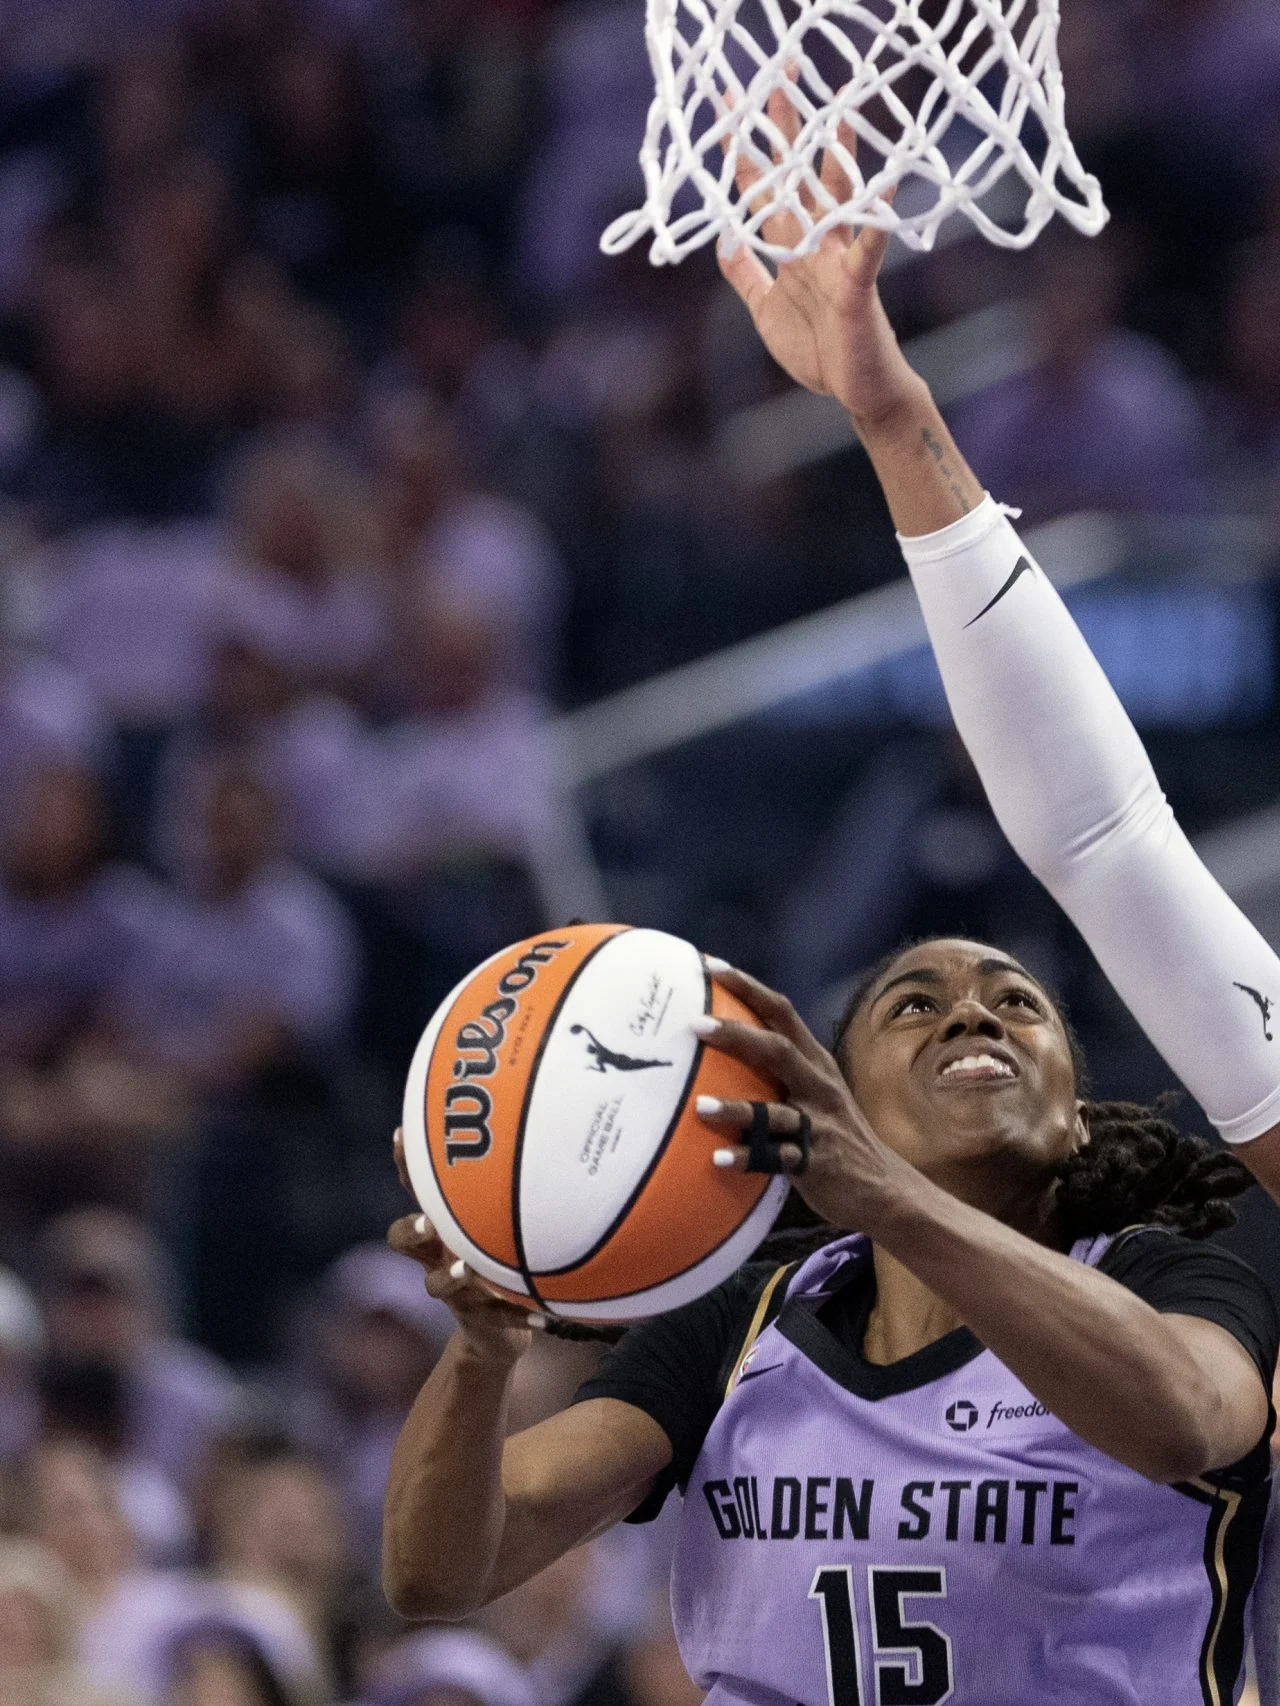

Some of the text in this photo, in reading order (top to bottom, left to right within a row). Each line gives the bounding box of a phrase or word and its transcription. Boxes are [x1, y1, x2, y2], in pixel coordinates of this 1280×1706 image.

[444, 938, 574, 1168] Wilson
[580, 1100, 608, 1164] OFFICIAL
[588, 1132, 610, 1176] GAME
[603, 1093, 625, 1132] BALL
[986, 1400, 1050, 1429] freedo
[702, 1476, 1079, 1545] GOLDEN STATE
[807, 1564, 955, 1706] 15
